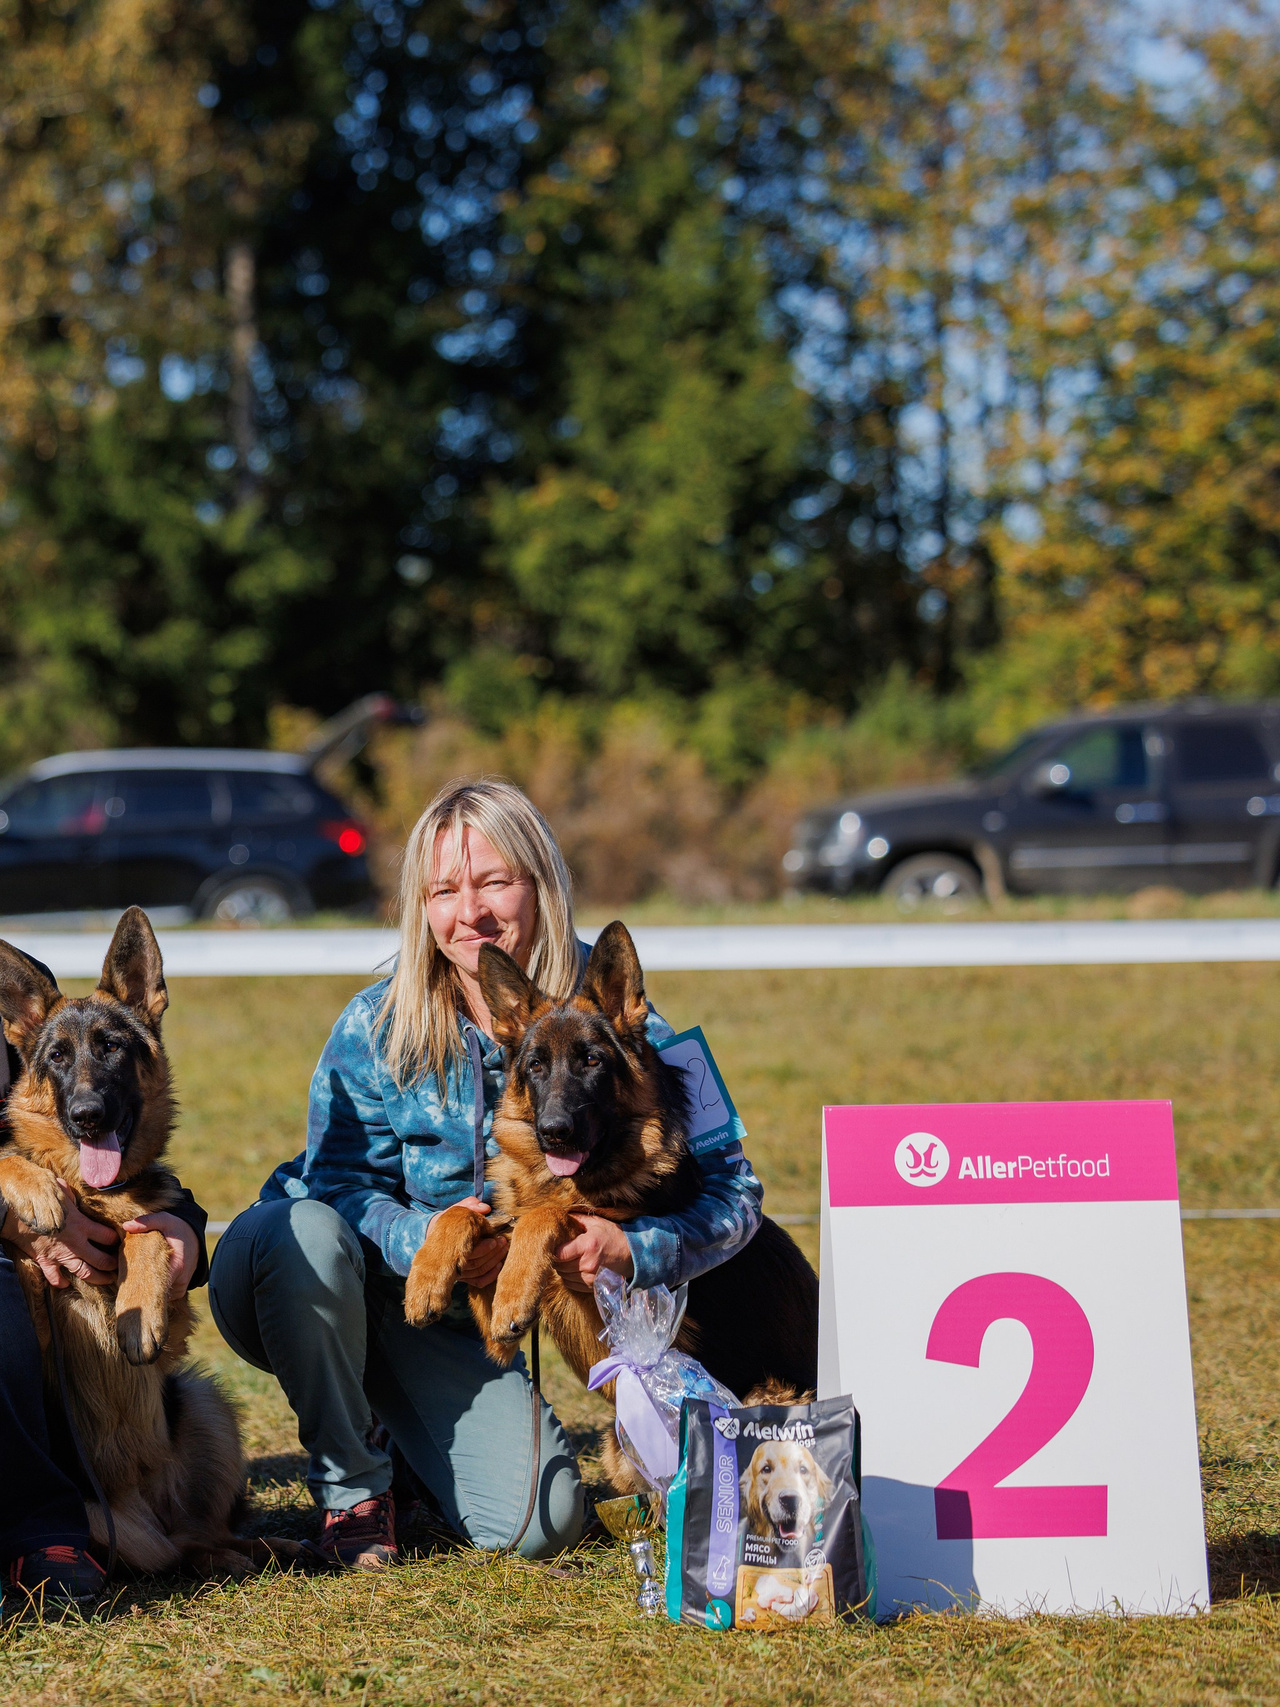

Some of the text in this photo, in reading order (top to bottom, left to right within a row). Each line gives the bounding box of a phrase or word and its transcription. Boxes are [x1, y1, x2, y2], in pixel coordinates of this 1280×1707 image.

[695, 1131, 729, 1151] Melwin
[958, 1153, 1110, 1180] AllerPetfood
[925, 1271, 1108, 1540] 2
[743, 1420, 814, 1441] Melwin
[716, 1454, 734, 1534] SENIOR
[745, 1543, 770, 1553] МЯСО
[746, 1534, 771, 1543] PREMIUM
[744, 1552, 777, 1565] ПТИЦЫ
